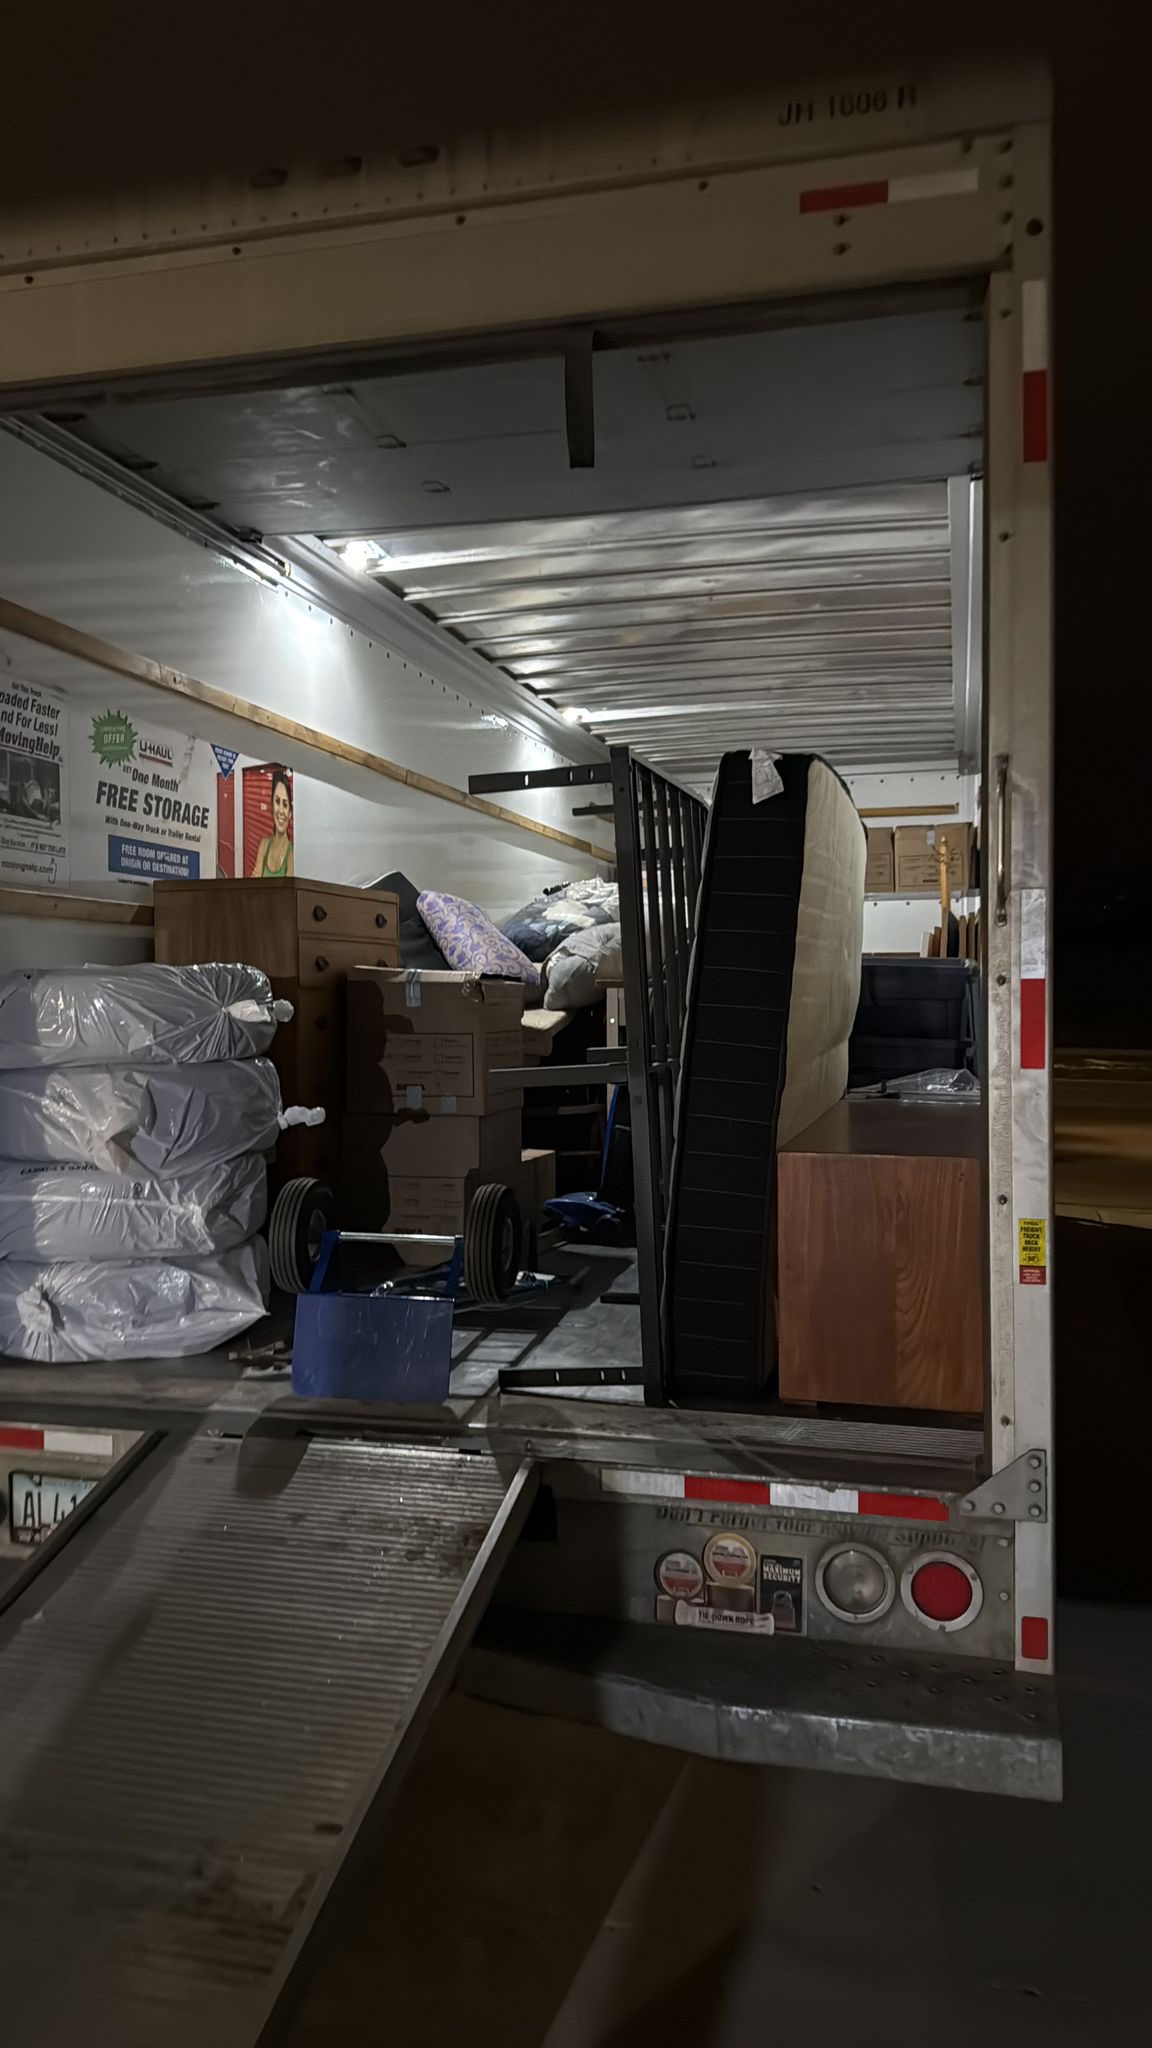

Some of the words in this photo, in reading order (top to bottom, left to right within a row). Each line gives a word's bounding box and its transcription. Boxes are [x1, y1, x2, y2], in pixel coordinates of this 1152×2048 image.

[779, 102, 814, 126] JH
[30, 698, 61, 721] Faster
[16, 712, 32, 729] For
[33, 717, 59, 737] Less!
[103, 733, 126, 745] OFFER
[139, 740, 173, 760] U-HAUL
[131, 768, 150, 785] One
[96, 781, 139, 813] FREE
[142, 792, 210, 829] STORAGE
[105, 815, 119, 826] With
[120, 818, 145, 832] One-Way
[145, 823, 160, 835] Truck
[160, 827, 167, 835] or
[168, 828, 184, 841] Trailer
[185, 832, 201, 842] Rental
[121, 843, 137, 855] FREE
[137, 846, 155, 859] ROOM
[182, 854, 190, 865] AT
[142, 860, 151, 871] OR
[763, 1563, 801, 1576] MAXIMUM
[763, 1572, 801, 1584] SECURITY
